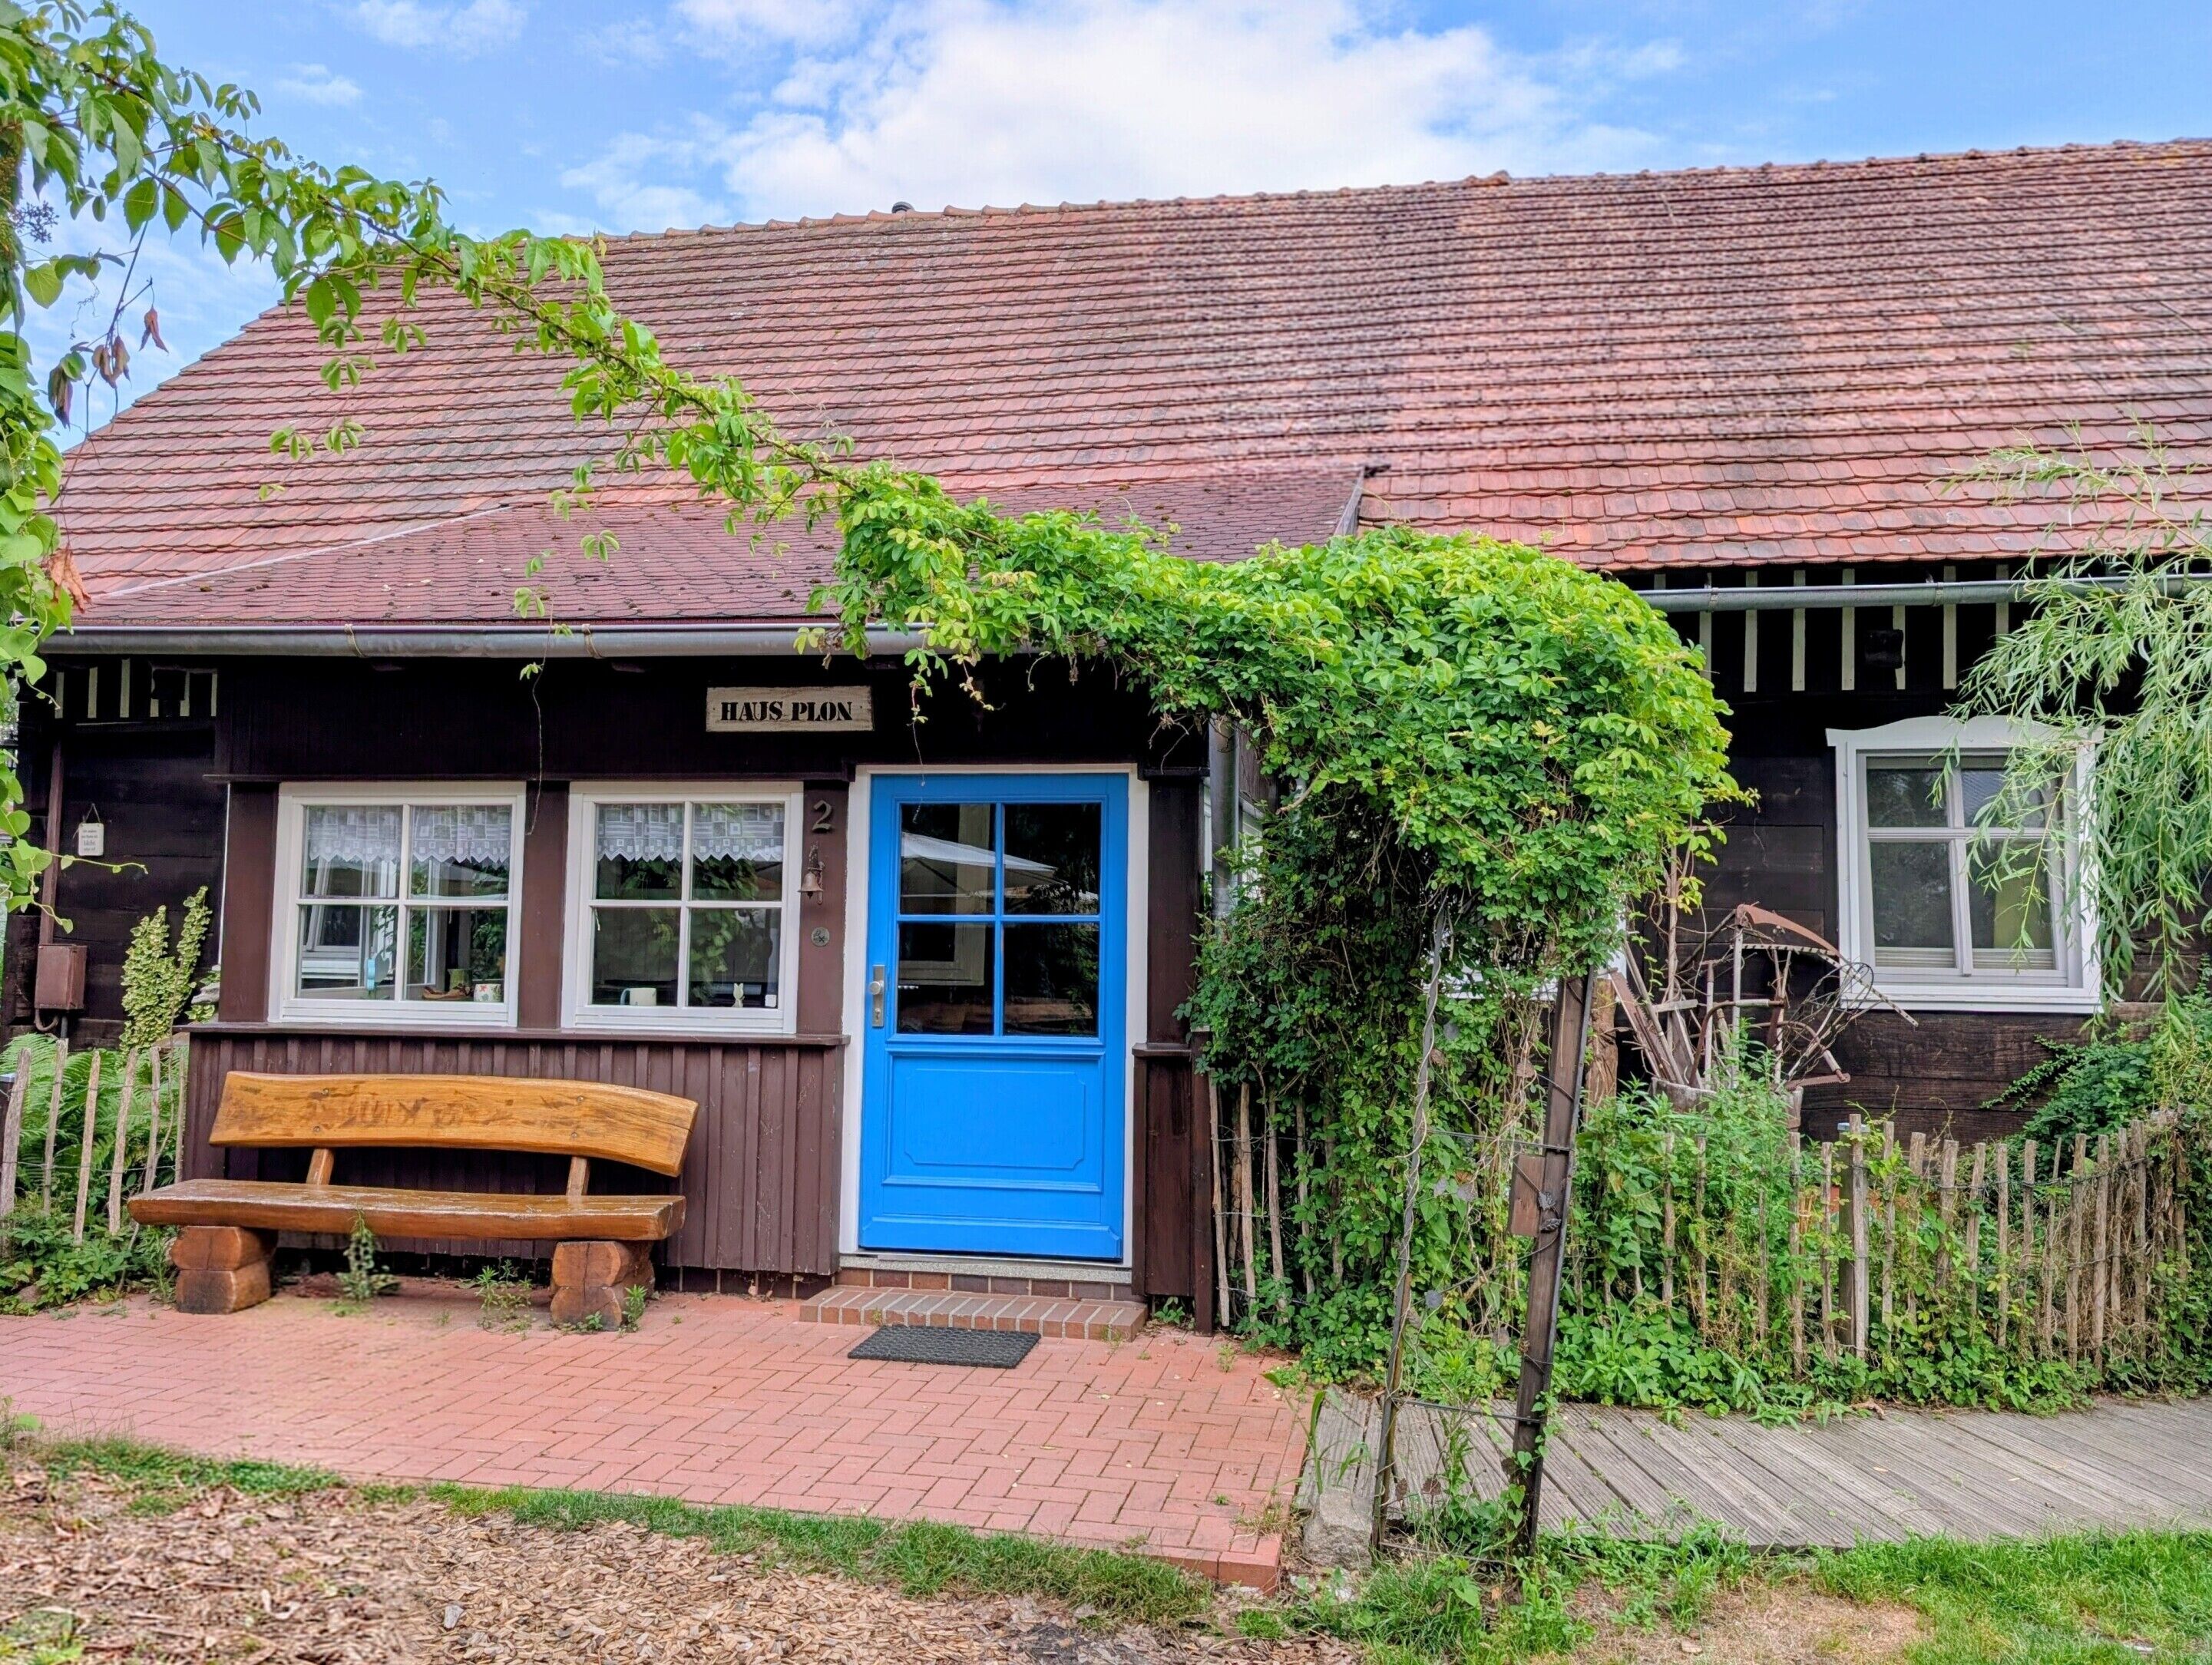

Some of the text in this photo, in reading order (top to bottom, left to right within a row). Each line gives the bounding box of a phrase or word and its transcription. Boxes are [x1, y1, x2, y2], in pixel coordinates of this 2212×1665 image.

[720, 700, 853, 722] HAUS PLON
[812, 799, 833, 831] 2
